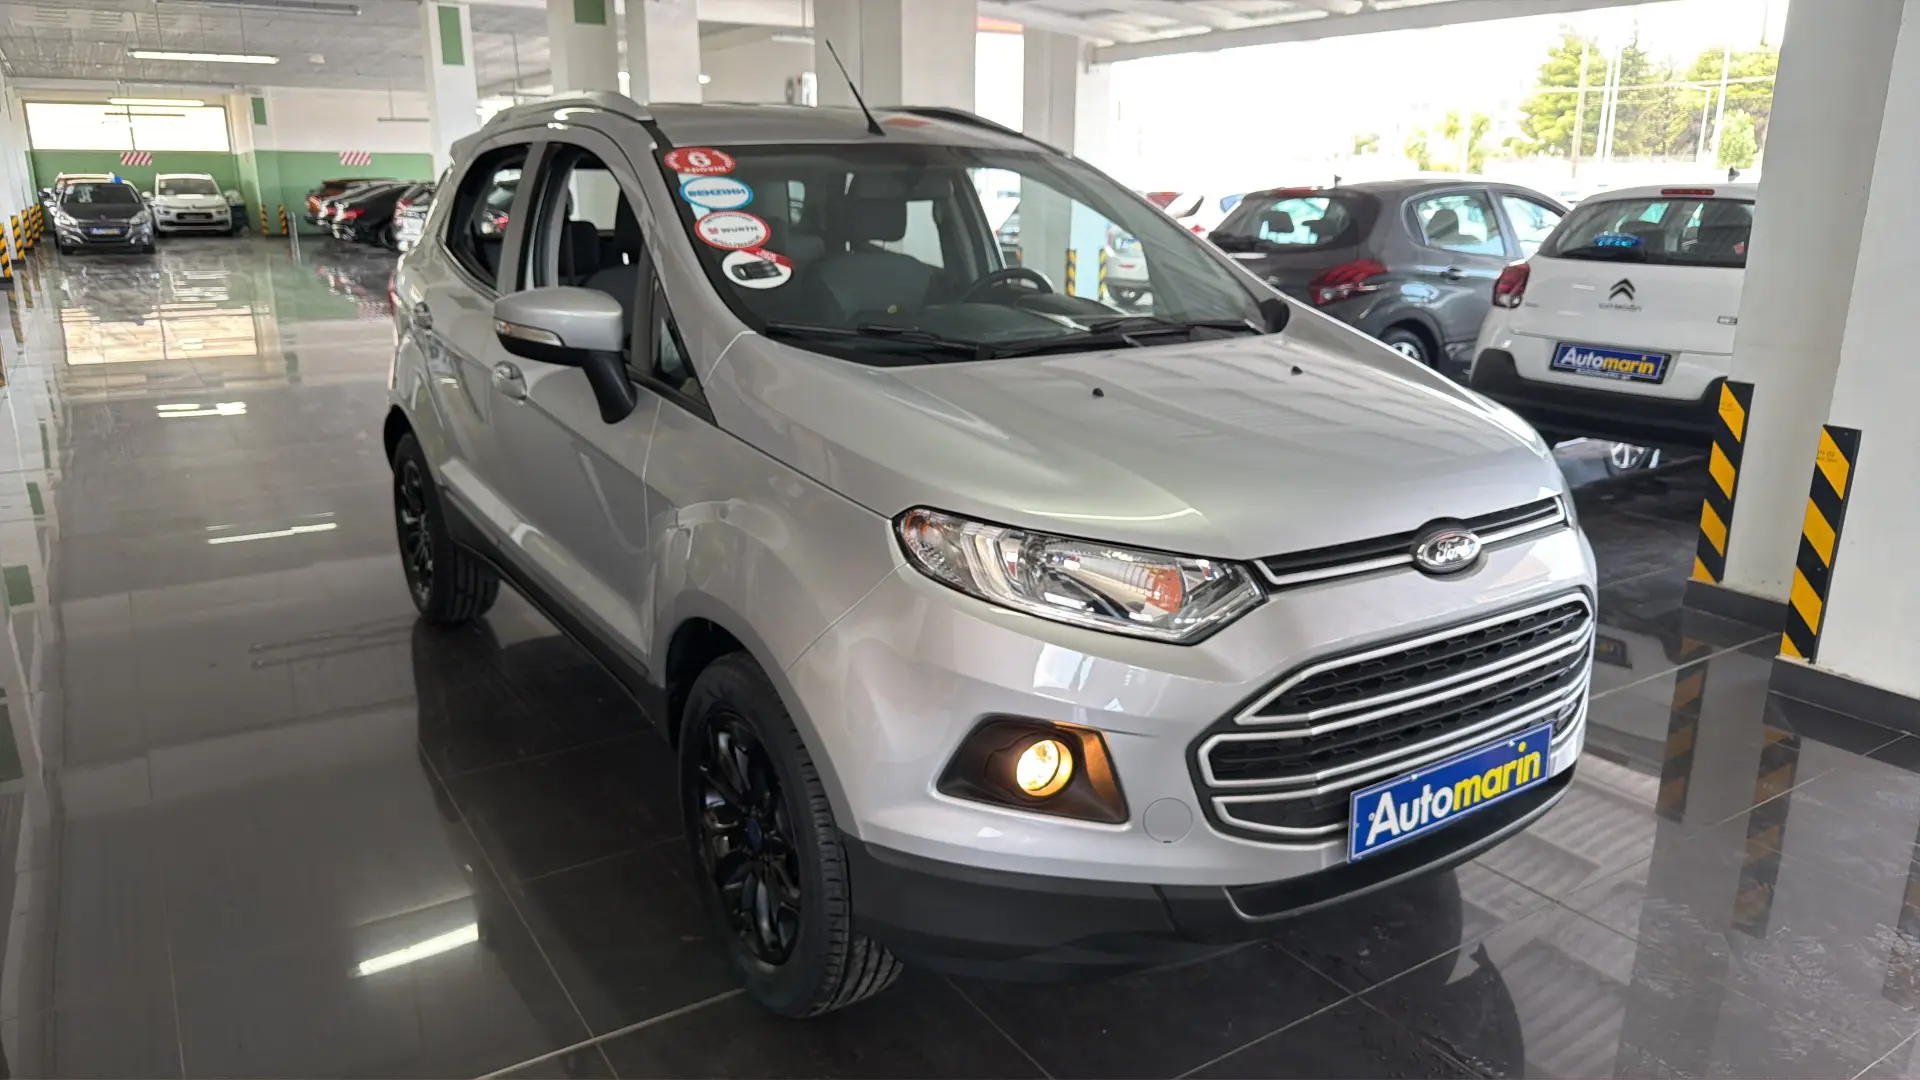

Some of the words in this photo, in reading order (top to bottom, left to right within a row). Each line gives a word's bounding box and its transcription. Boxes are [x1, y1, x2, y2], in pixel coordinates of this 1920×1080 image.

[1560, 346, 1655, 375] Automarin
[1435, 536, 1470, 563] Ford
[1365, 741, 1541, 846] Automarin
